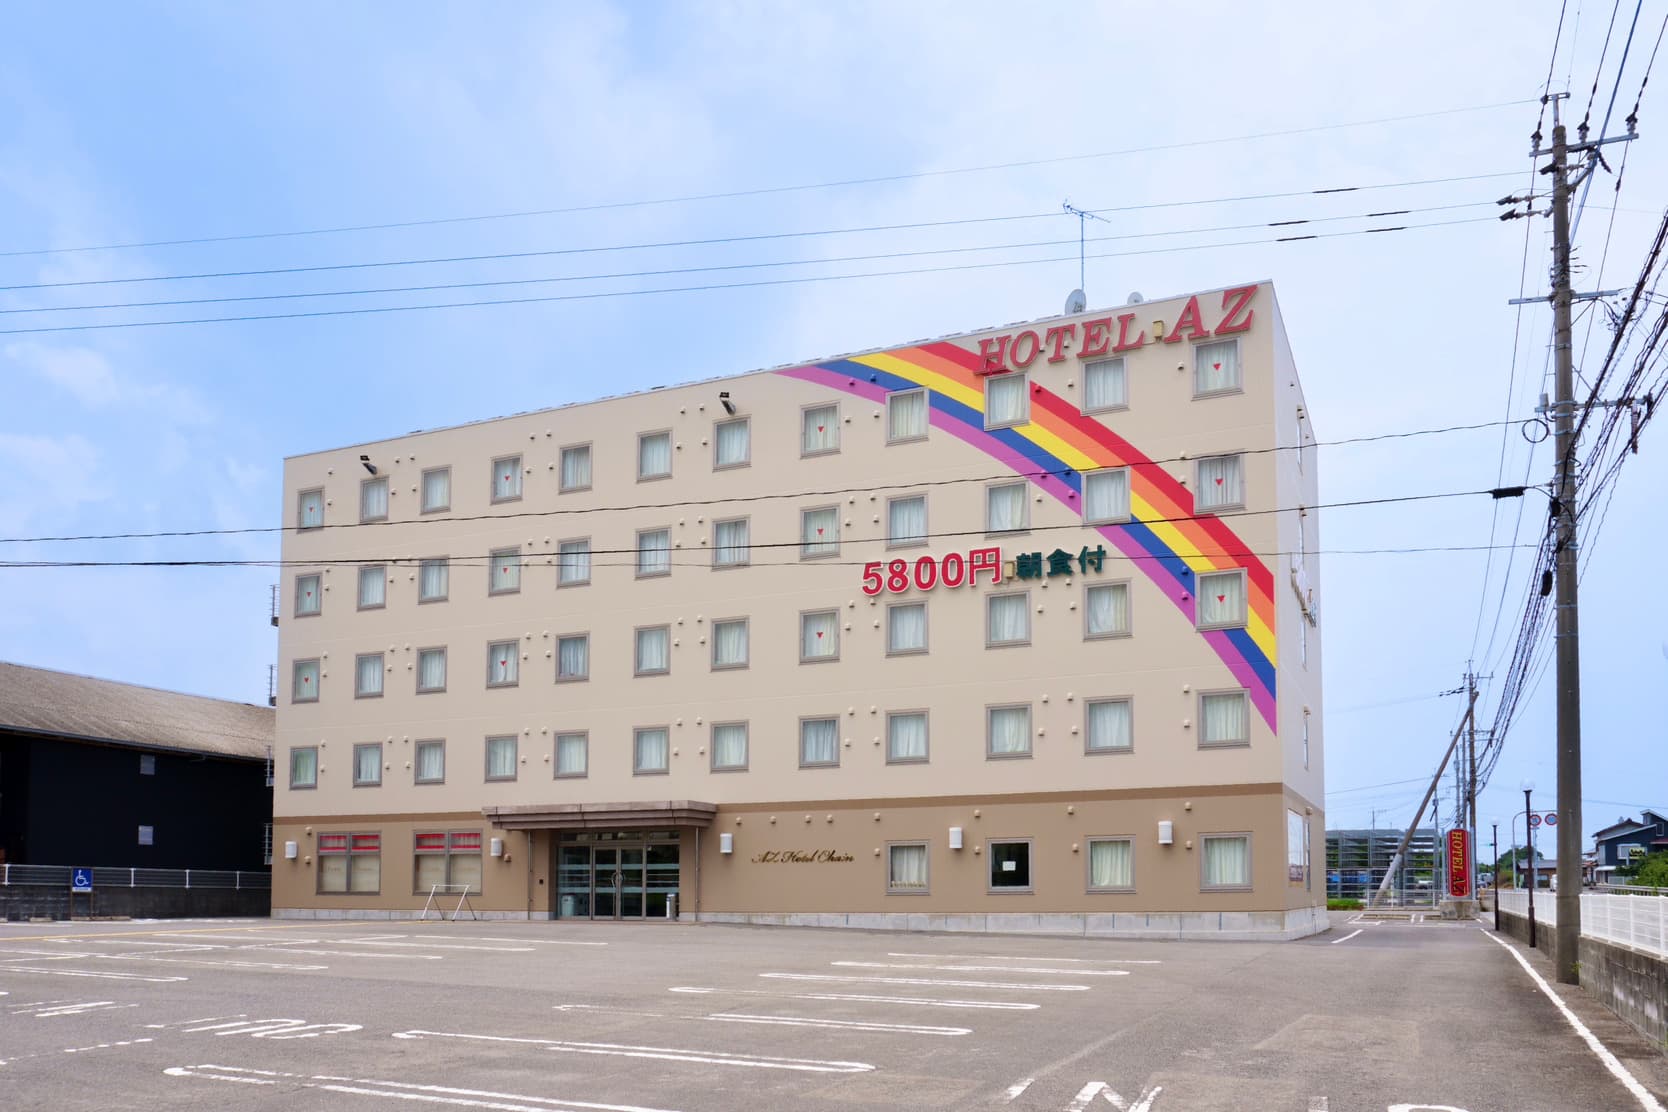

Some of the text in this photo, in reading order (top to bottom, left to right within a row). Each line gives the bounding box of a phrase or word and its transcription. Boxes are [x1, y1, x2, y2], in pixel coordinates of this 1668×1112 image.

[974, 285, 1259, 376] HOTEL AZ
[862, 547, 1002, 596] 5800円
[780, 849, 819, 864] Hotel
[817, 849, 855, 864] Chain
[1452, 831, 1463, 872] HOTEL
